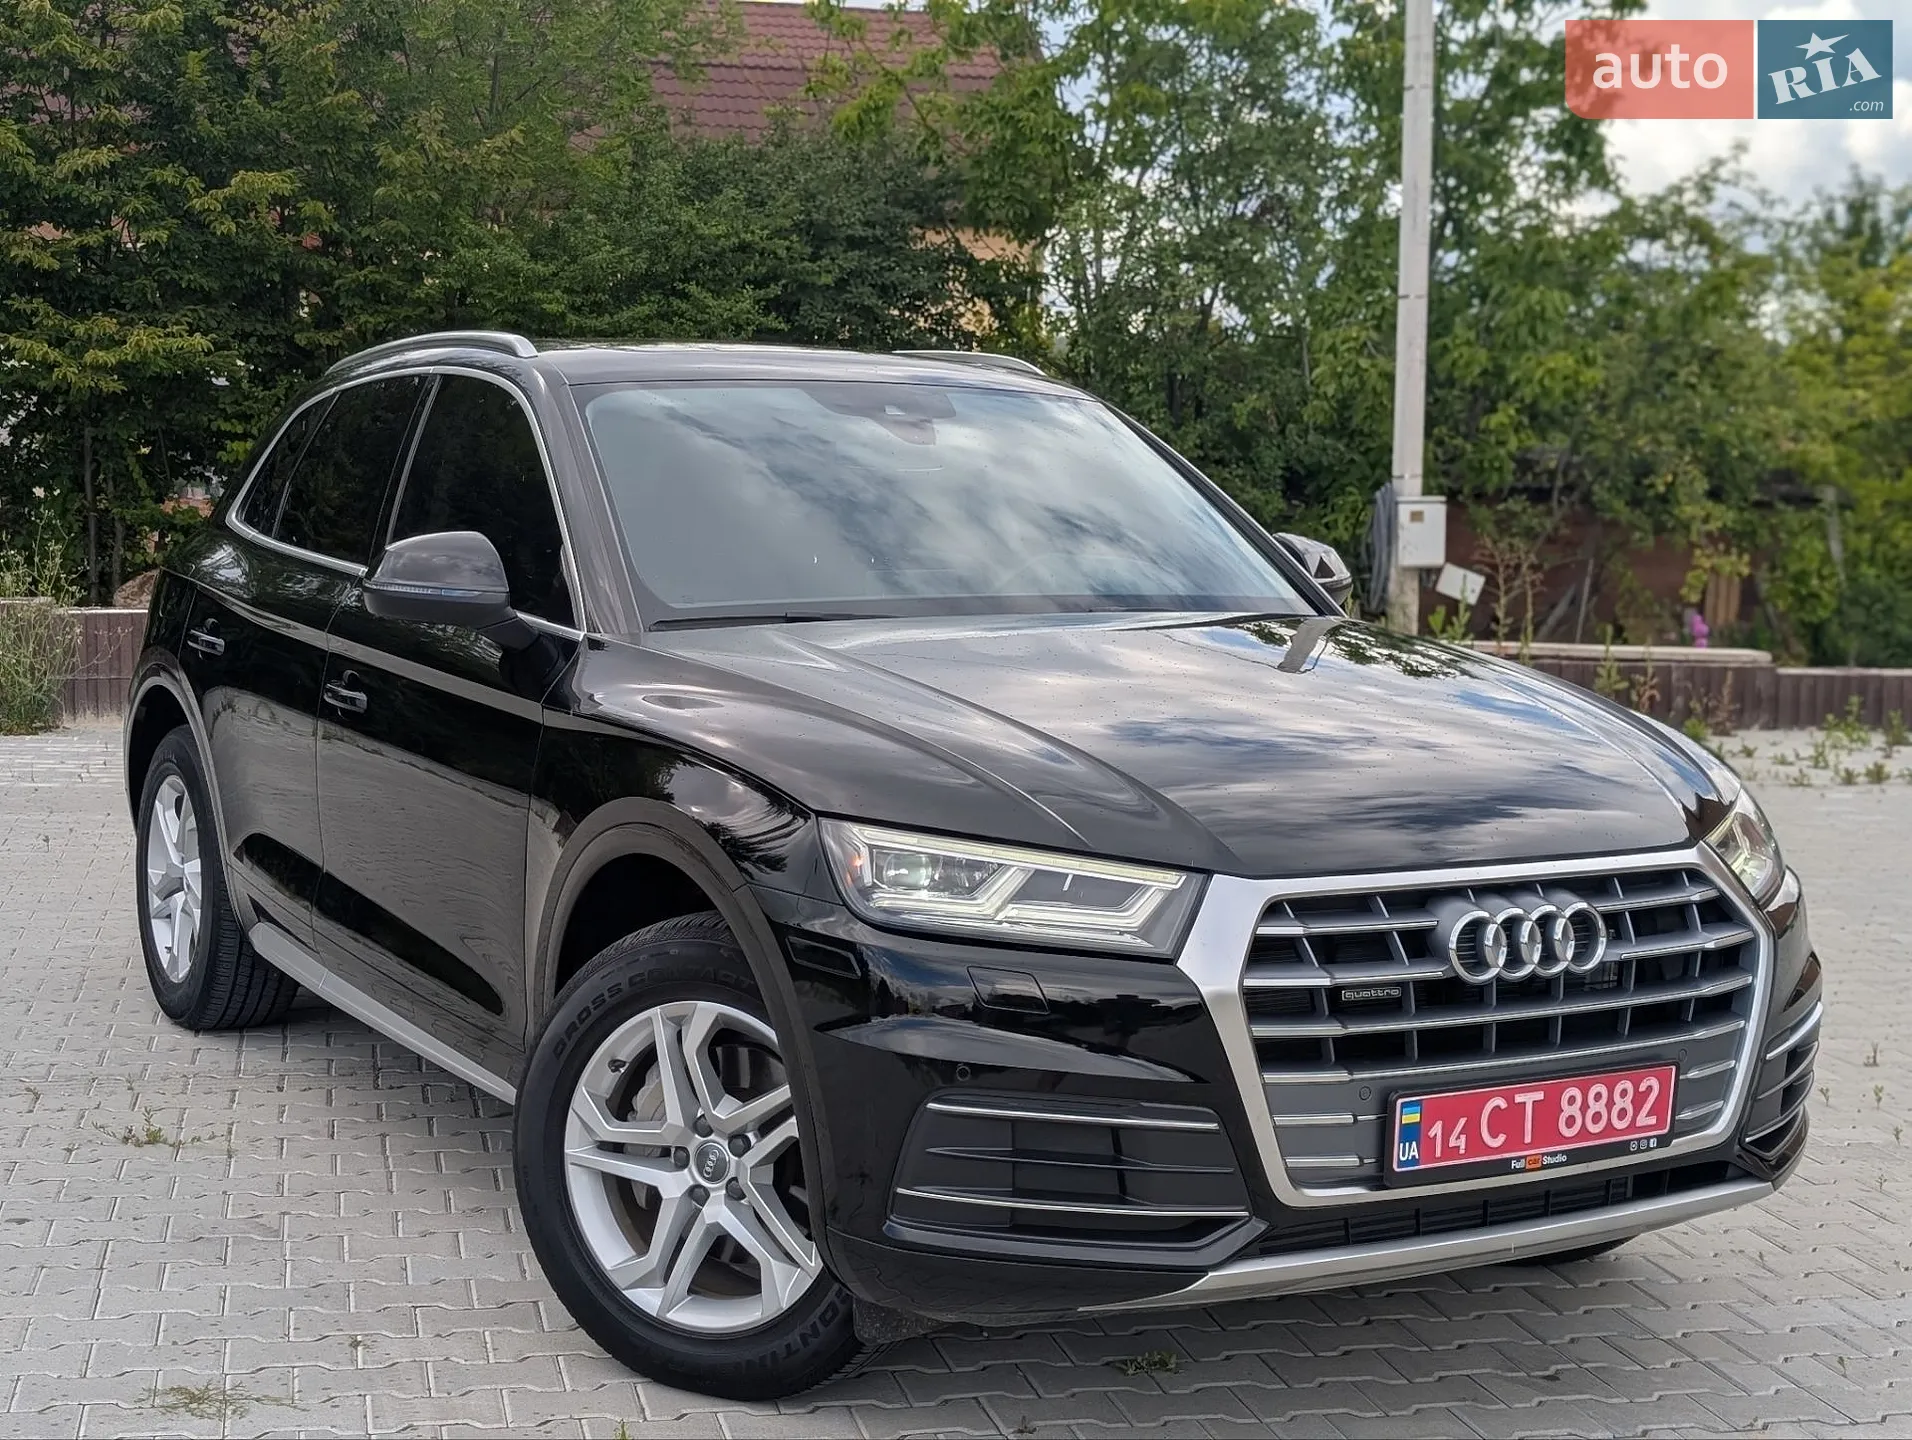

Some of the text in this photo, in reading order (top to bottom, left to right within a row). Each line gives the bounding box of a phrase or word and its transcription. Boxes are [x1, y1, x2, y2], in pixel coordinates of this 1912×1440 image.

[1344, 988, 1400, 1000] quattro
[1427, 1075, 1661, 1159] 14 CT 8882
[1399, 1141, 1419, 1161] UA
[1511, 1158, 1526, 1169] Full
[1542, 1153, 1567, 1165] Studio
